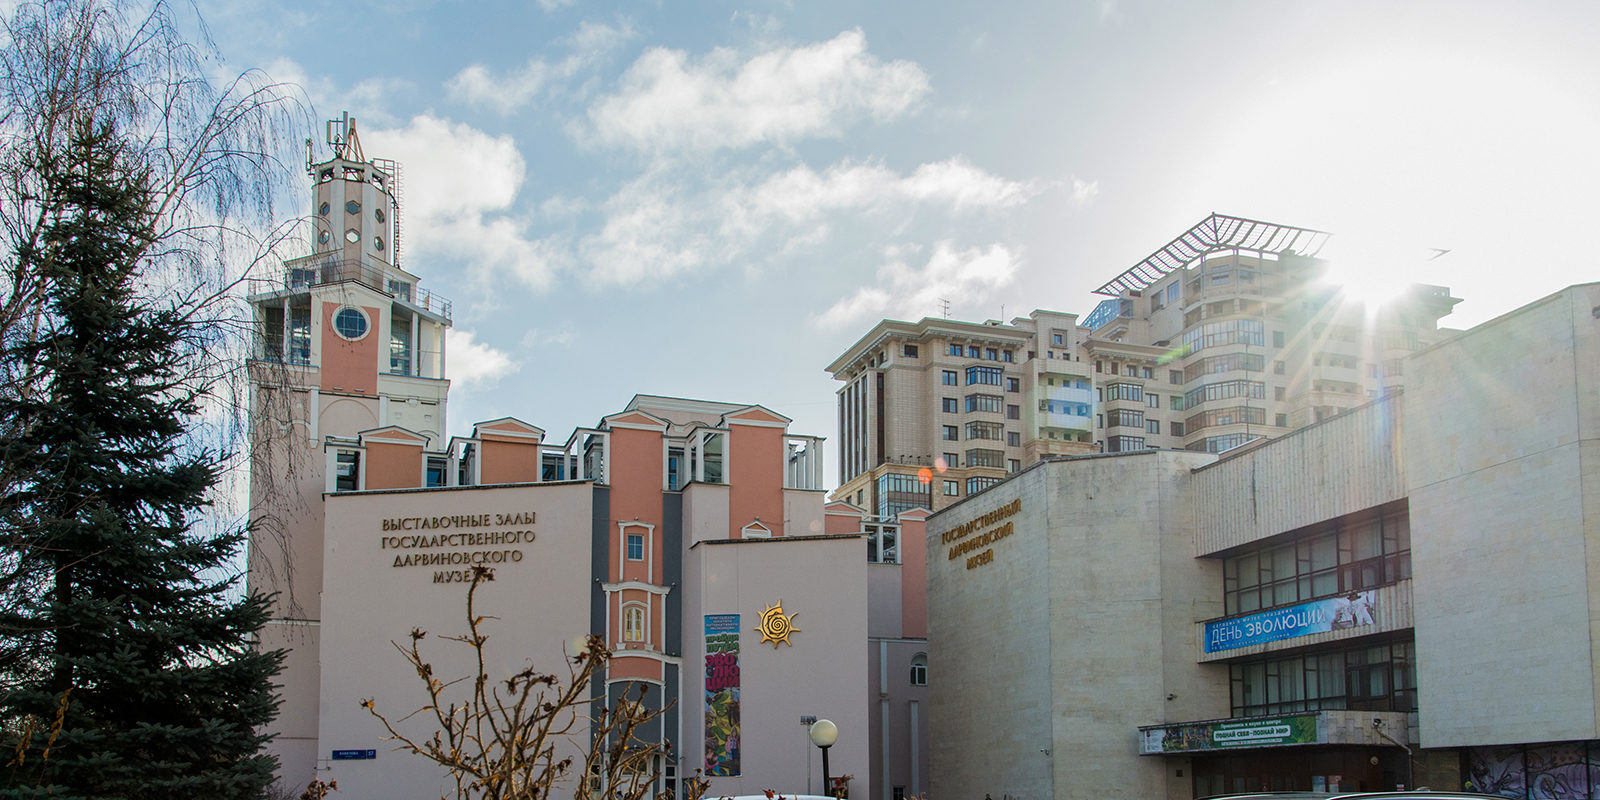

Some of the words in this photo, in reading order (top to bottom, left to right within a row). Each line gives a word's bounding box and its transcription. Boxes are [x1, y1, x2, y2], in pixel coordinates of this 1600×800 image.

[382, 514, 491, 531] ВЫСТАВОЧНЫЕ
[495, 512, 536, 526] ЗАЛЫ
[942, 498, 1021, 545] ГОСУДАРСТВЕННЫЙ
[382, 530, 536, 549] ГОСУДАРСТВЕННОГО
[948, 521, 1014, 560] ДАРВИНОВСКИЙ
[393, 550, 523, 567] ДАРВИНОВСКОГО
[966, 548, 994, 570] МУЗЕЙ
[433, 569, 481, 583] МУЗЕ
[1211, 625, 1243, 647] ДЕНЬ
[1245, 608, 1326, 637] ЭВОЛЮЦИИ
